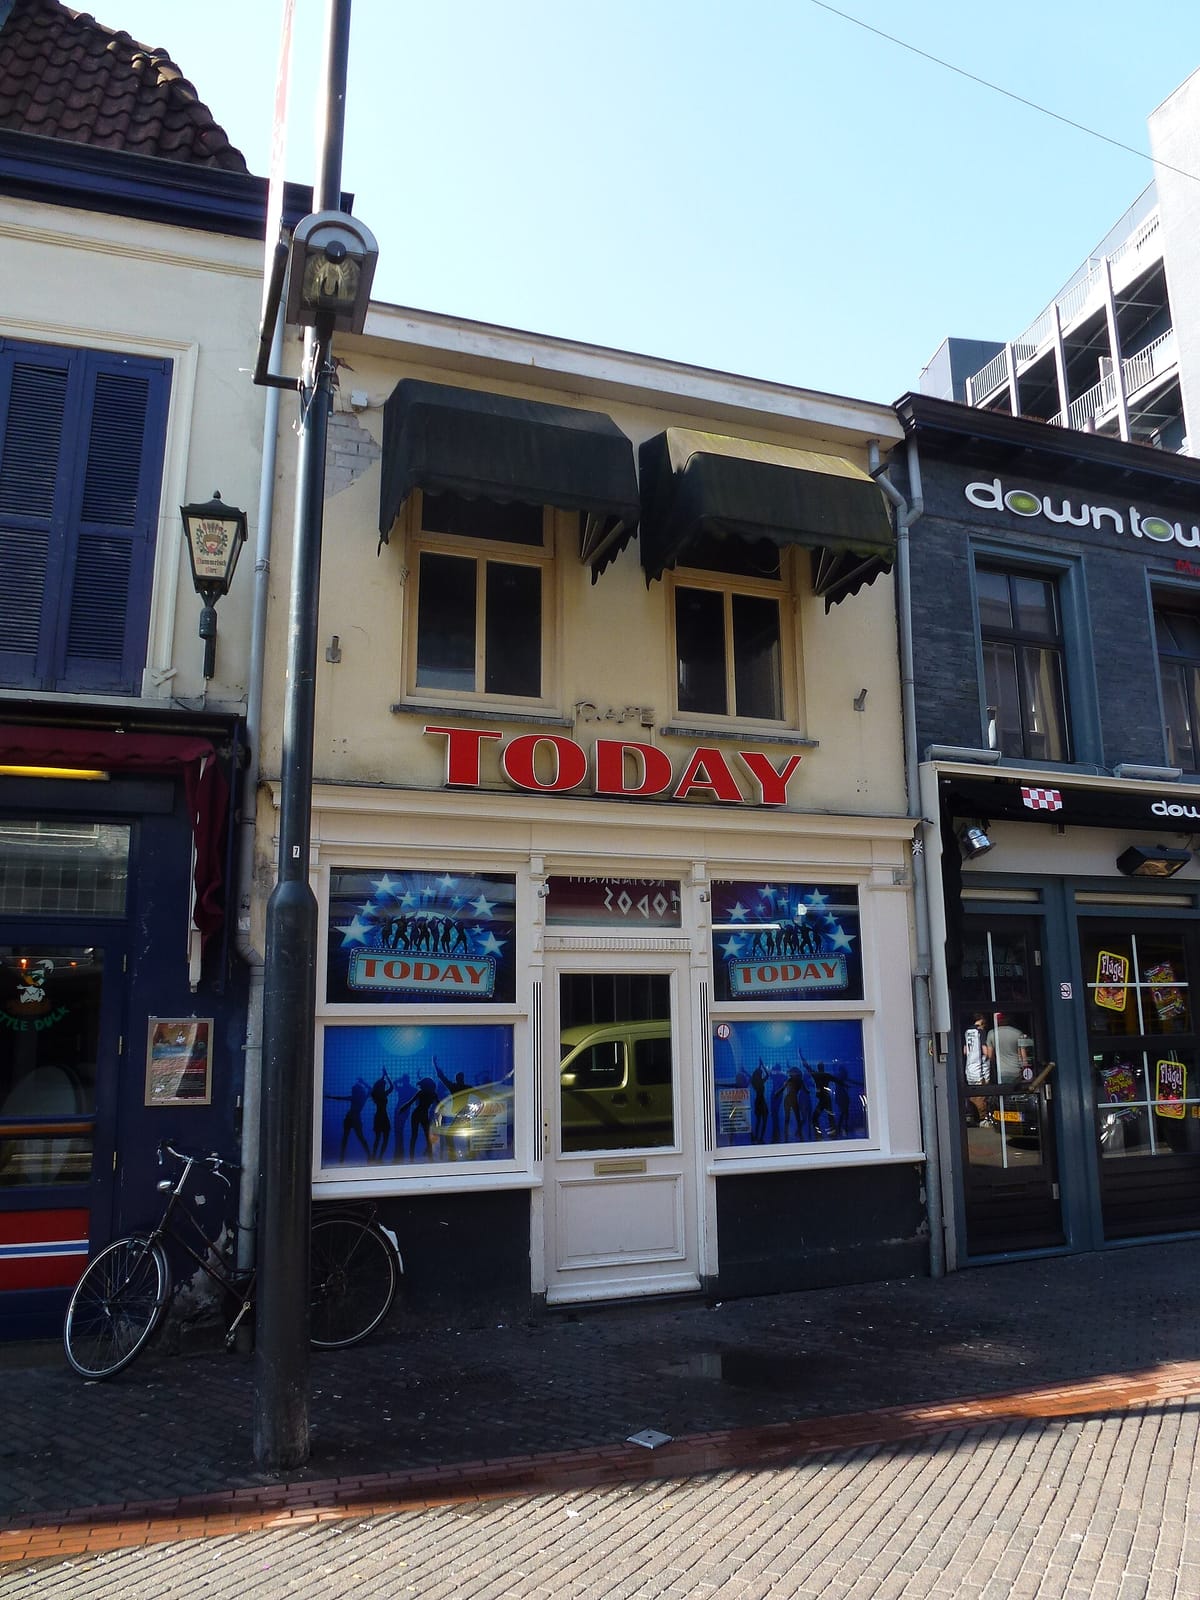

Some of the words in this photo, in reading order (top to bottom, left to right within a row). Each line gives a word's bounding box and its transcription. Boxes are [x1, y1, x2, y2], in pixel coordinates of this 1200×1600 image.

[424, 725, 802, 806] TODAY
[359, 958, 487, 985] TODAY
[737, 961, 838, 984] TODAY
